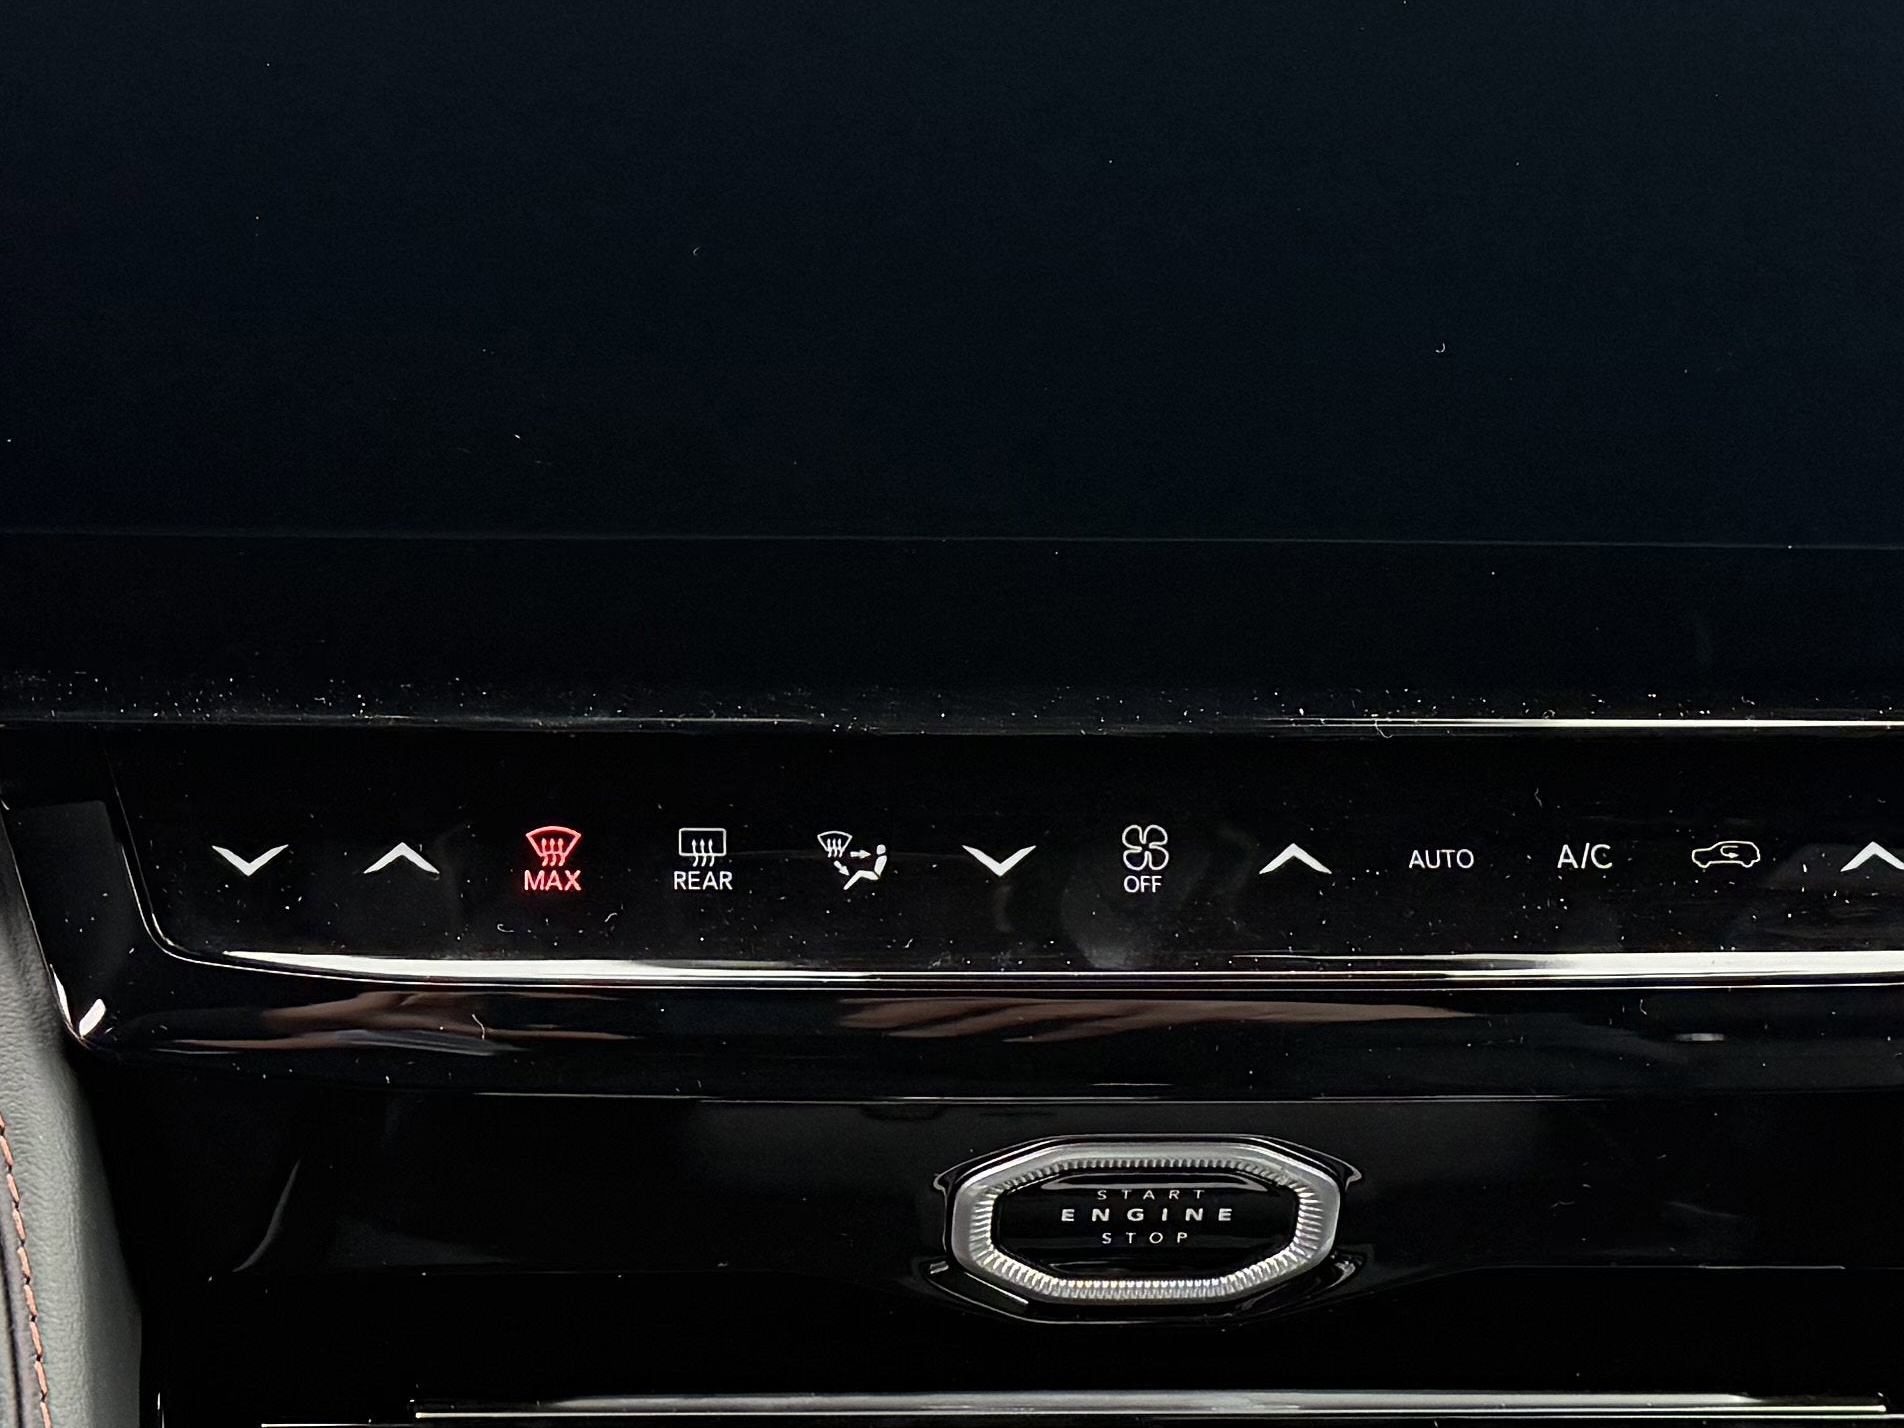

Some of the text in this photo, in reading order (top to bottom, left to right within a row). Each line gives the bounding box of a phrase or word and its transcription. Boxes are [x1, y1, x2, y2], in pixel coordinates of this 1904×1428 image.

[1409, 848, 1475, 870] AUTO
[1556, 843, 1613, 871] A/C
[523, 870, 582, 892] MAX
[673, 870, 733, 891] REAR
[1123, 874, 1162, 894] OFF
[1097, 1189, 1205, 1200] START
[1061, 1208, 1233, 1222] ENGINE
[1102, 1232, 1188, 1244] STOP
